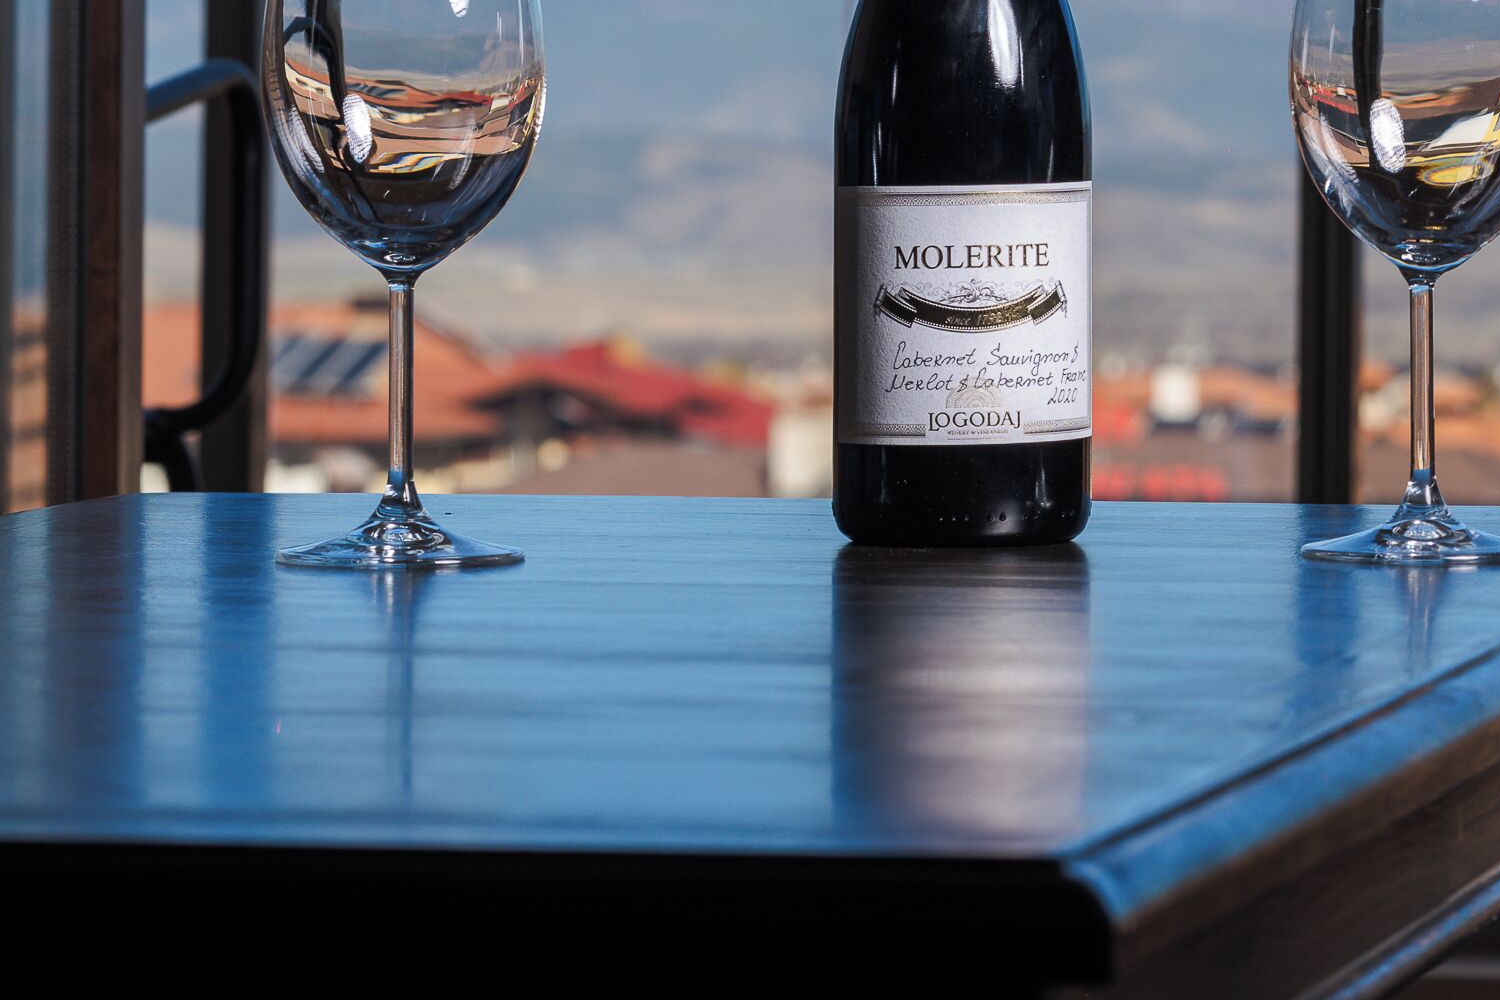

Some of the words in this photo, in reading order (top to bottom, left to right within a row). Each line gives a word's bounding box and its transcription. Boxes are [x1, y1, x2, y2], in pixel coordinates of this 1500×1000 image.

[894, 243, 1050, 269] MOLERITE
[893, 340, 976, 370] Cabernet
[986, 342, 1069, 376] Sauvignon
[885, 373, 954, 393] Merlot
[973, 367, 1053, 389] Cabernet
[1060, 368, 1086, 384] Franc
[1047, 387, 1077, 405] 2020
[928, 410, 1021, 431] LOGODAJ
